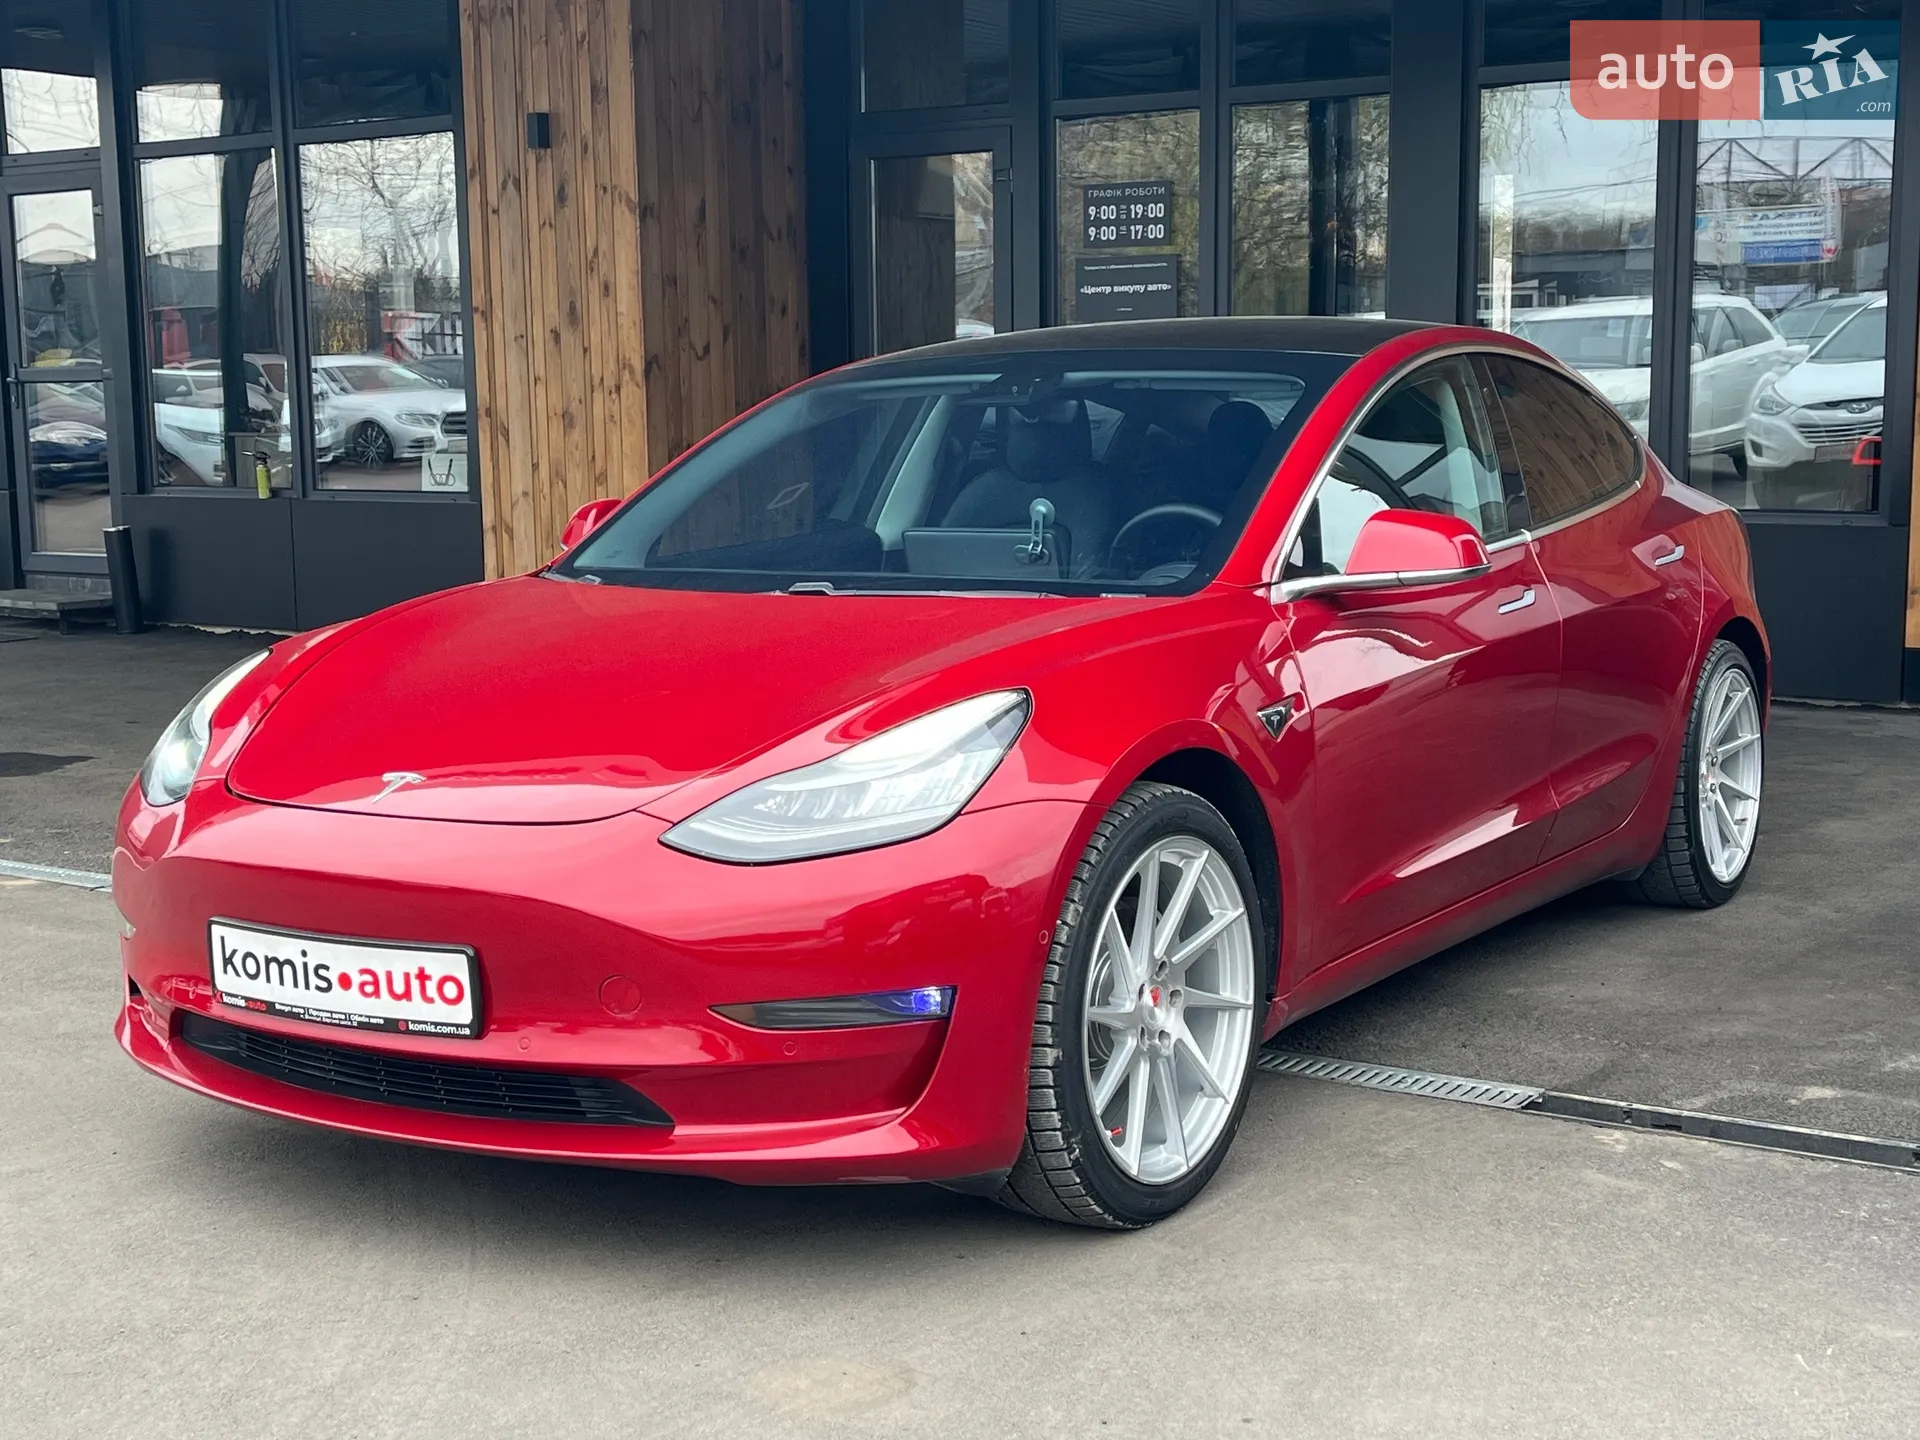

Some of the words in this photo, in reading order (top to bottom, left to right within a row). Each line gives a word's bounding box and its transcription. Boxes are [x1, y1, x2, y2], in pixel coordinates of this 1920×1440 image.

[1088, 189, 1122, 198] ГРАФІК
[1125, 187, 1165, 197] РОБОТИ
[1088, 205, 1117, 220] 9:00
[1130, 203, 1165, 219] 19:00
[1088, 226, 1117, 241] 9:00
[1130, 224, 1165, 240] 17:00
[1080, 285, 1112, 295] «Центр
[1113, 284, 1147, 294] викупу
[1147, 283, 1172, 292] авто»
[408, 1020, 471, 1036] komis.com.ua
